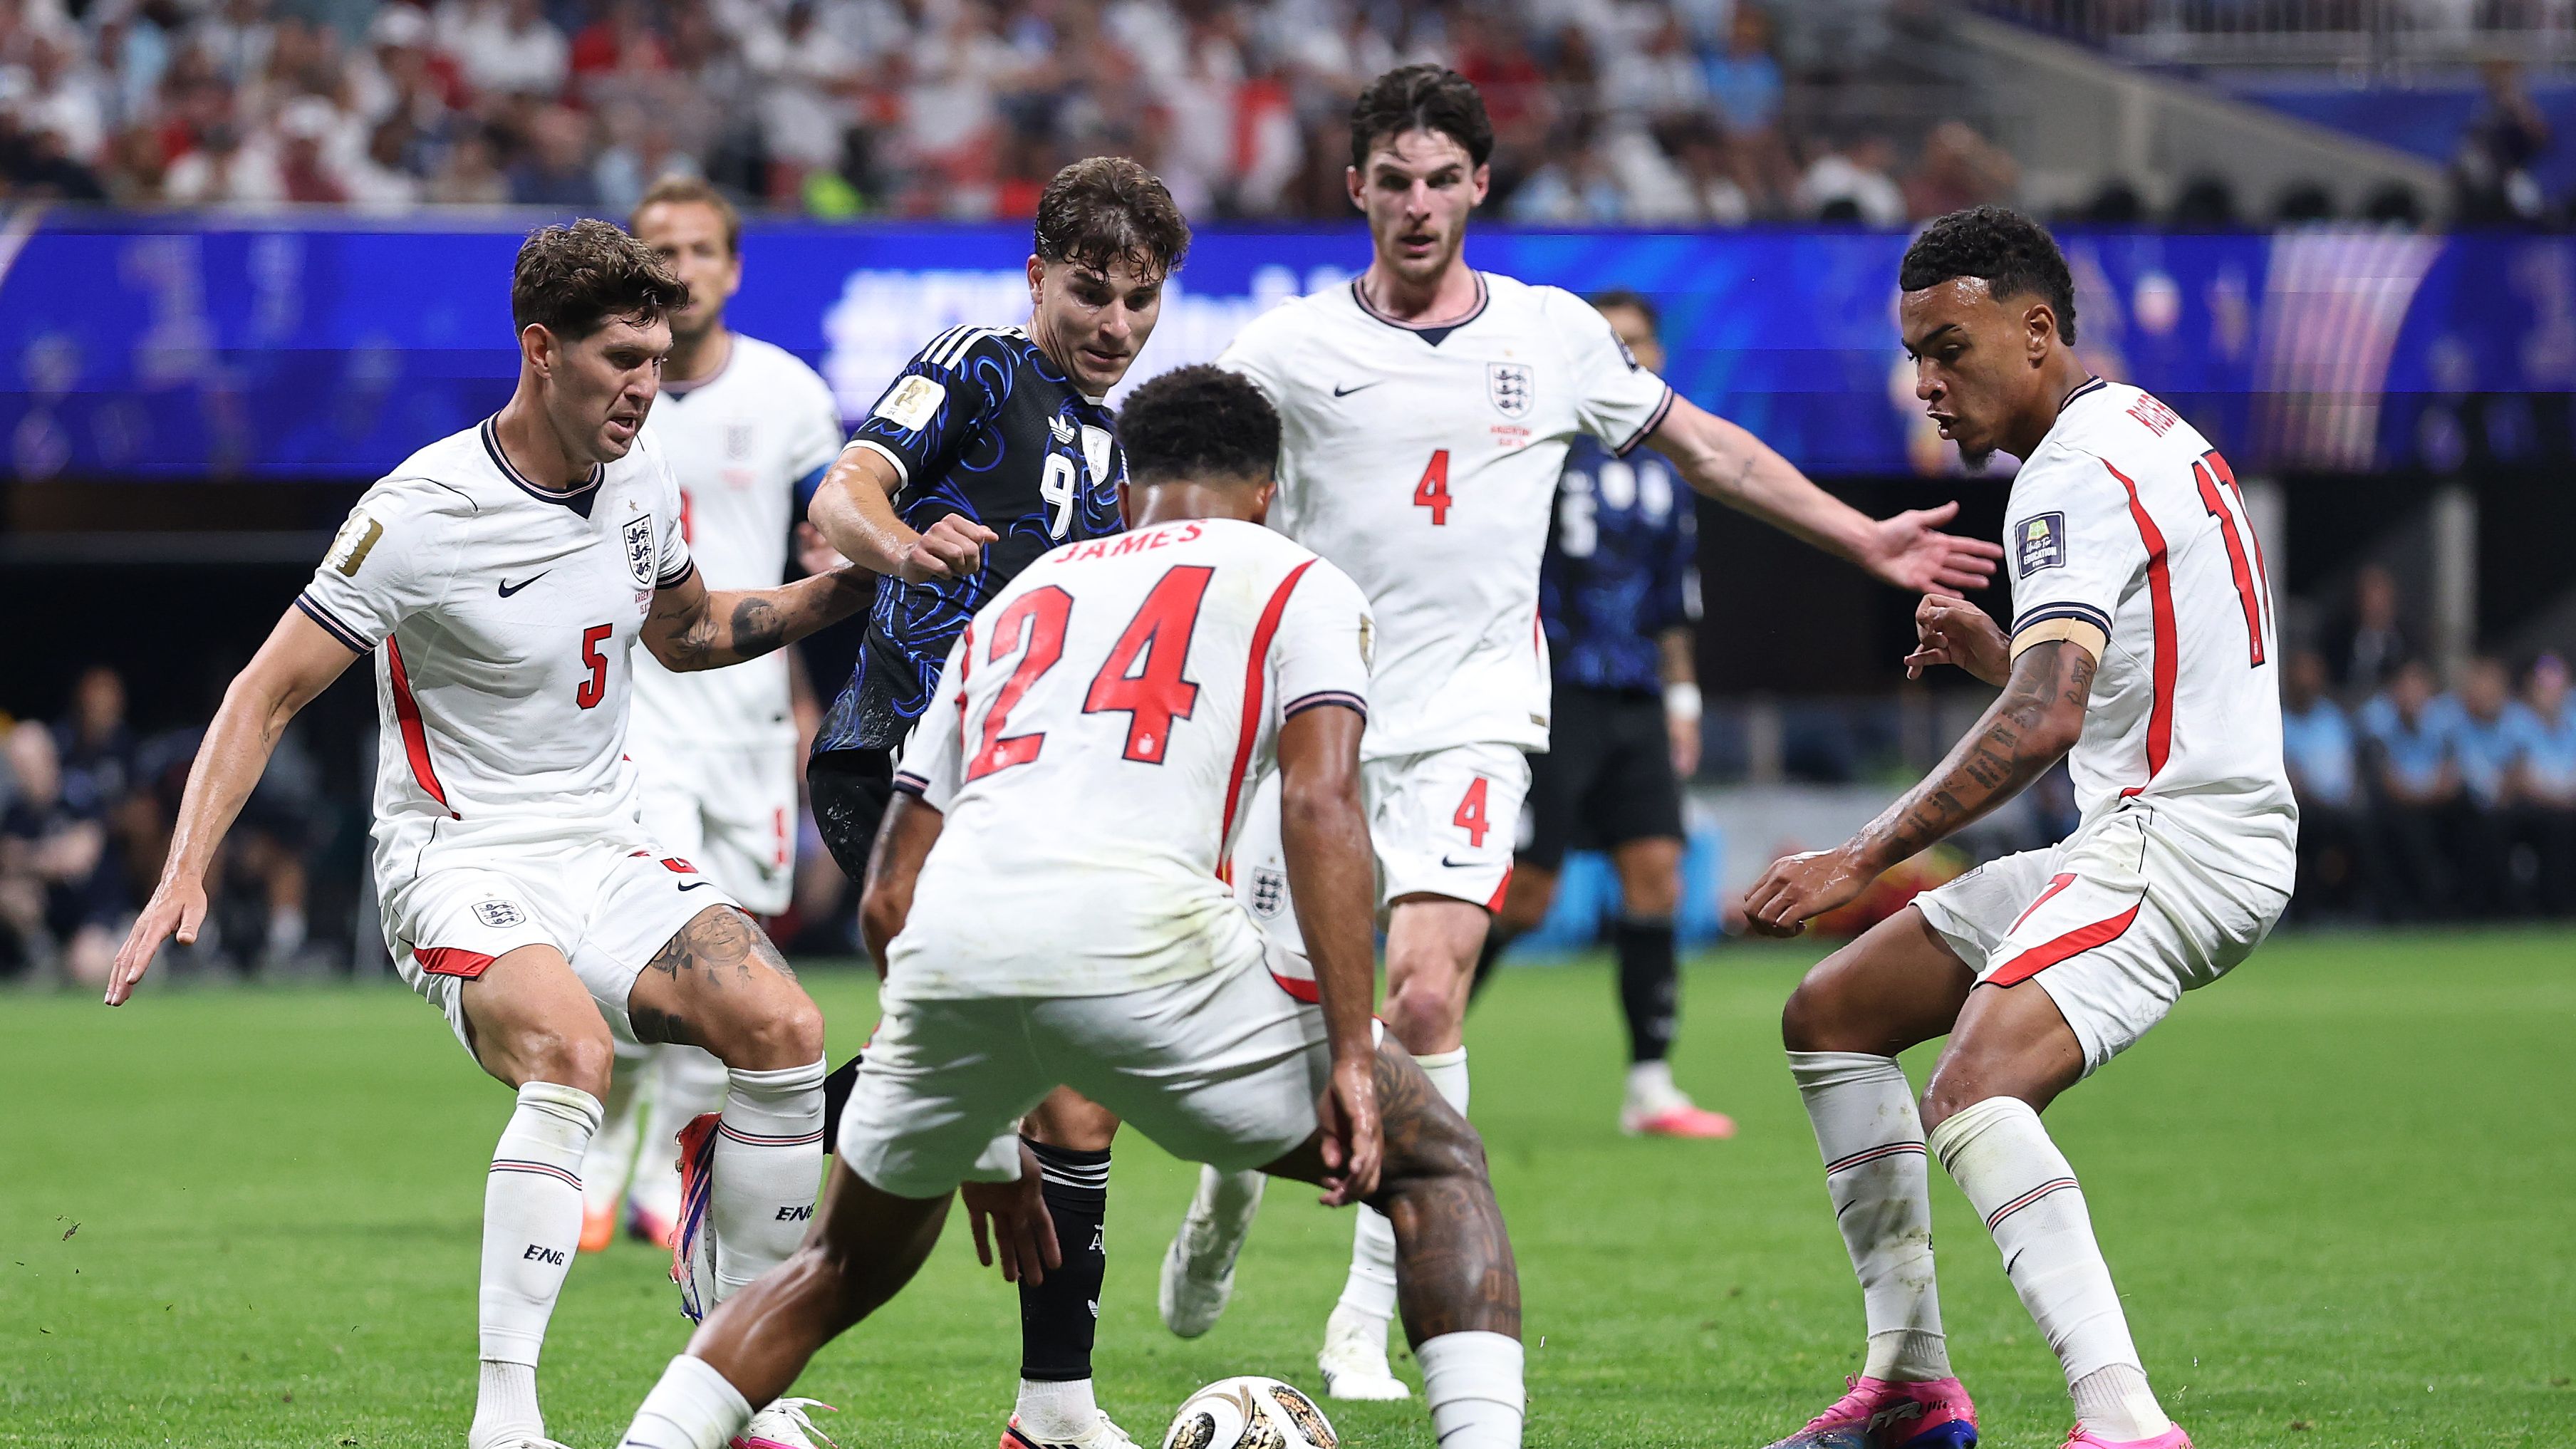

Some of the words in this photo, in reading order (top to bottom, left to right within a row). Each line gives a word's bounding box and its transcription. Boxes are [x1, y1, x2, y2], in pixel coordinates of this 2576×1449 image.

[1040, 452, 1076, 541] 9
[1413, 449, 1452, 525] 4
[1053, 518, 1209, 564] JAMES
[2023, 546, 2057, 565] EDUCATION
[576, 622, 613, 710] 5
[965, 564, 1217, 784] 24
[1454, 777, 1490, 848] 4
[524, 1244, 565, 1267] ENG
